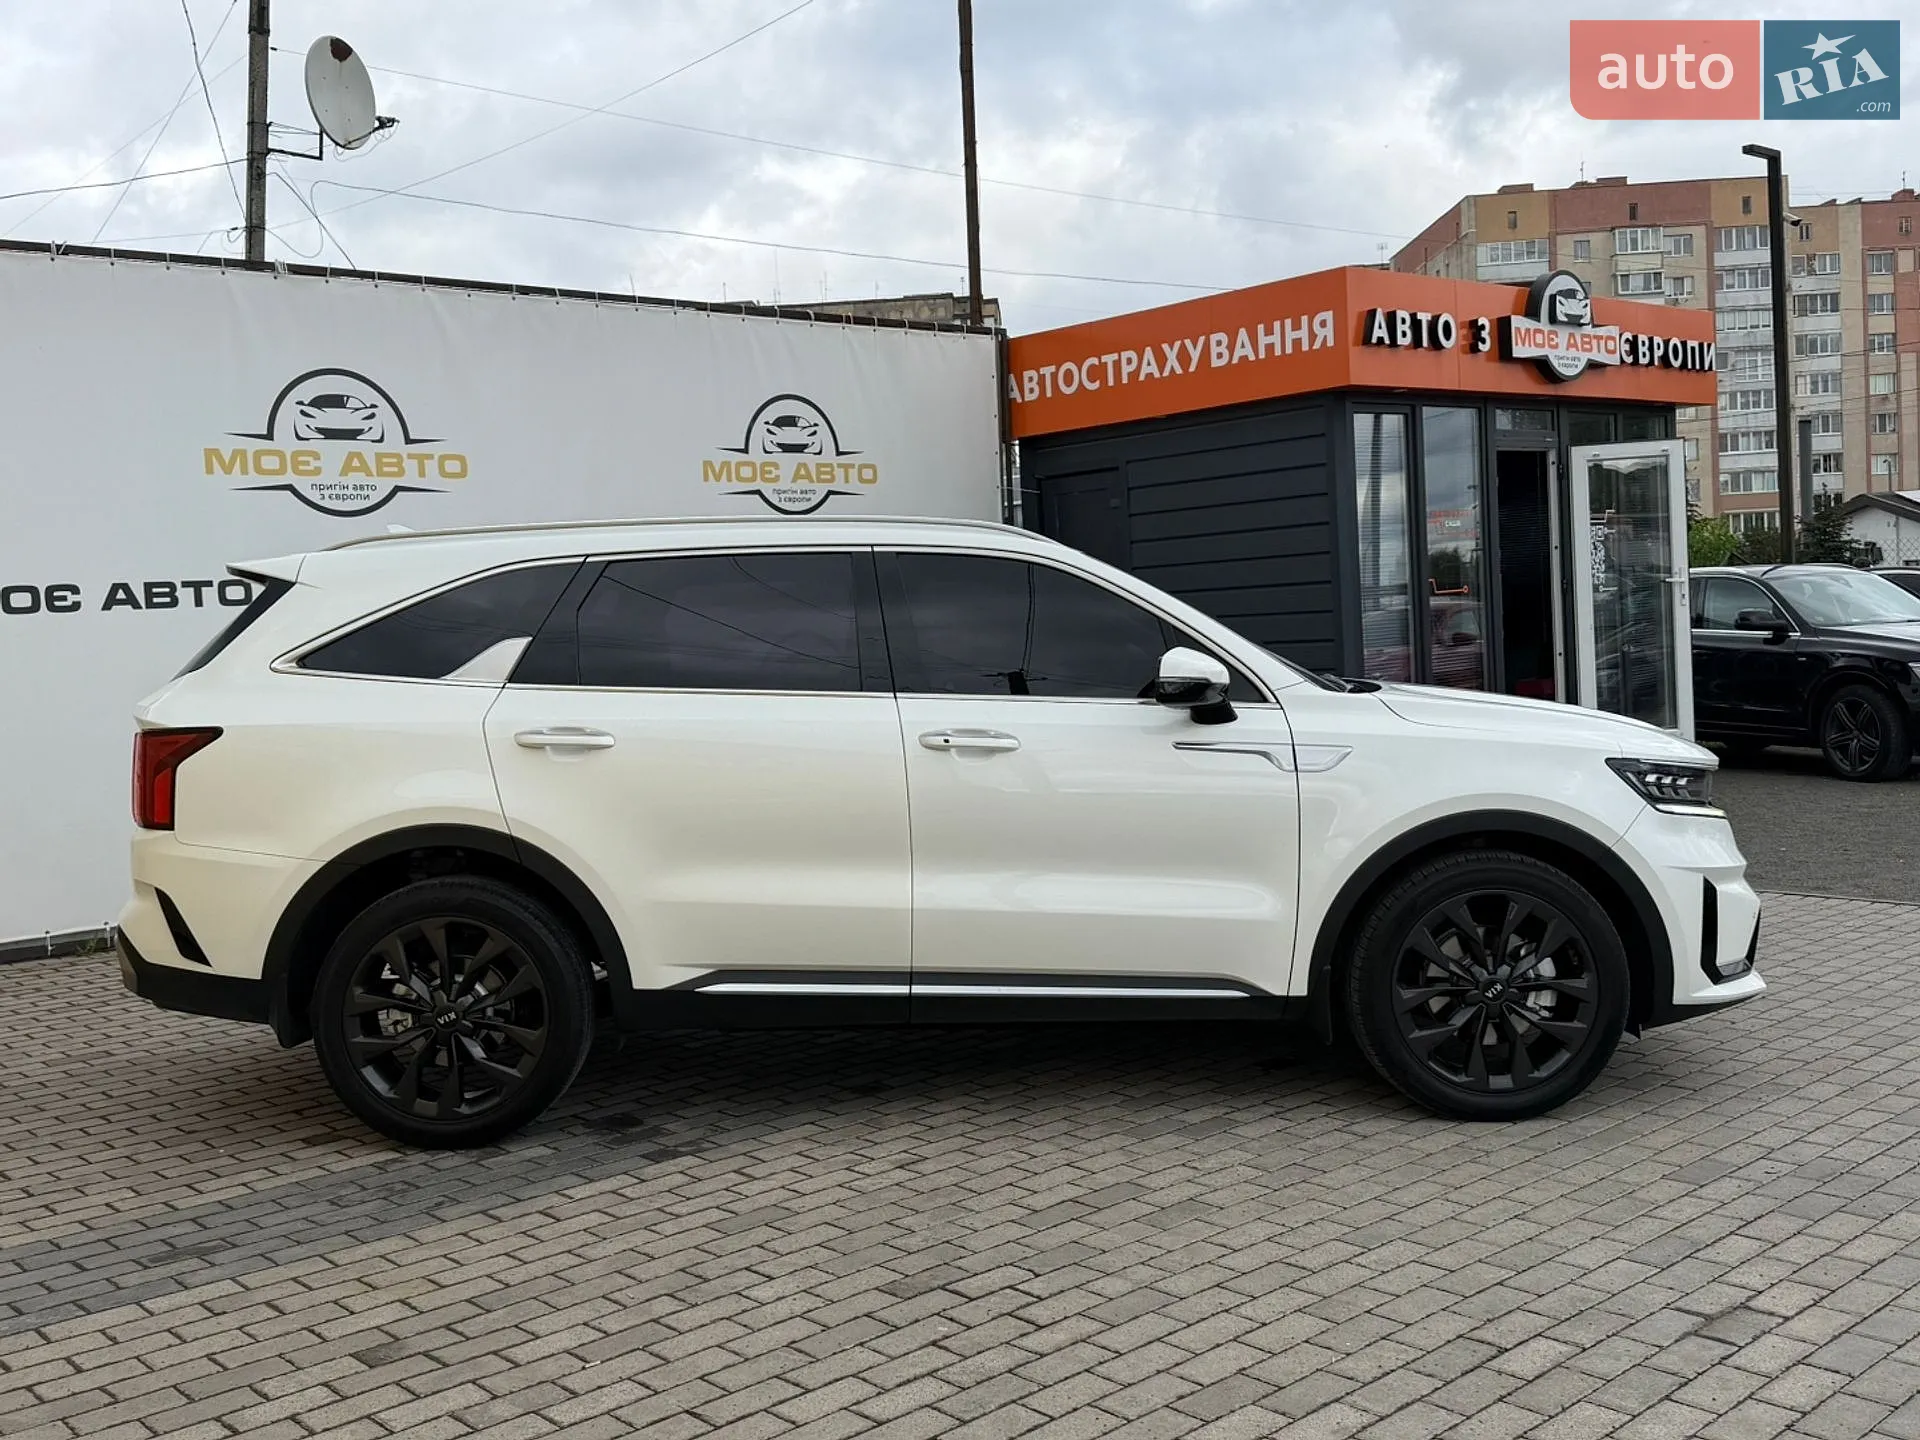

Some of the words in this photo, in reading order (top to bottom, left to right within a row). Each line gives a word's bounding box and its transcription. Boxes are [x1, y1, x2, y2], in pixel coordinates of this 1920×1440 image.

[1370, 308, 1457, 349] АВТО
[1620, 332, 1716, 371] ЄВРОПИ
[1514, 326, 1560, 349] МОЄ
[1566, 331, 1618, 355] АВТО
[1007, 310, 1335, 404] АВТОСТРАХУВАННЯ
[203, 447, 322, 477] МОЄ
[339, 451, 469, 480] АВТО
[702, 460, 780, 484] МОЄ
[791, 462, 878, 485] АВТО
[310, 481, 349, 492] пригін
[352, 483, 377, 491] авто
[328, 493, 370, 502] європи
[101, 578, 253, 612] АВТО
[1484, 982, 1503, 998] KIA
[437, 1011, 457, 1024] KIA
